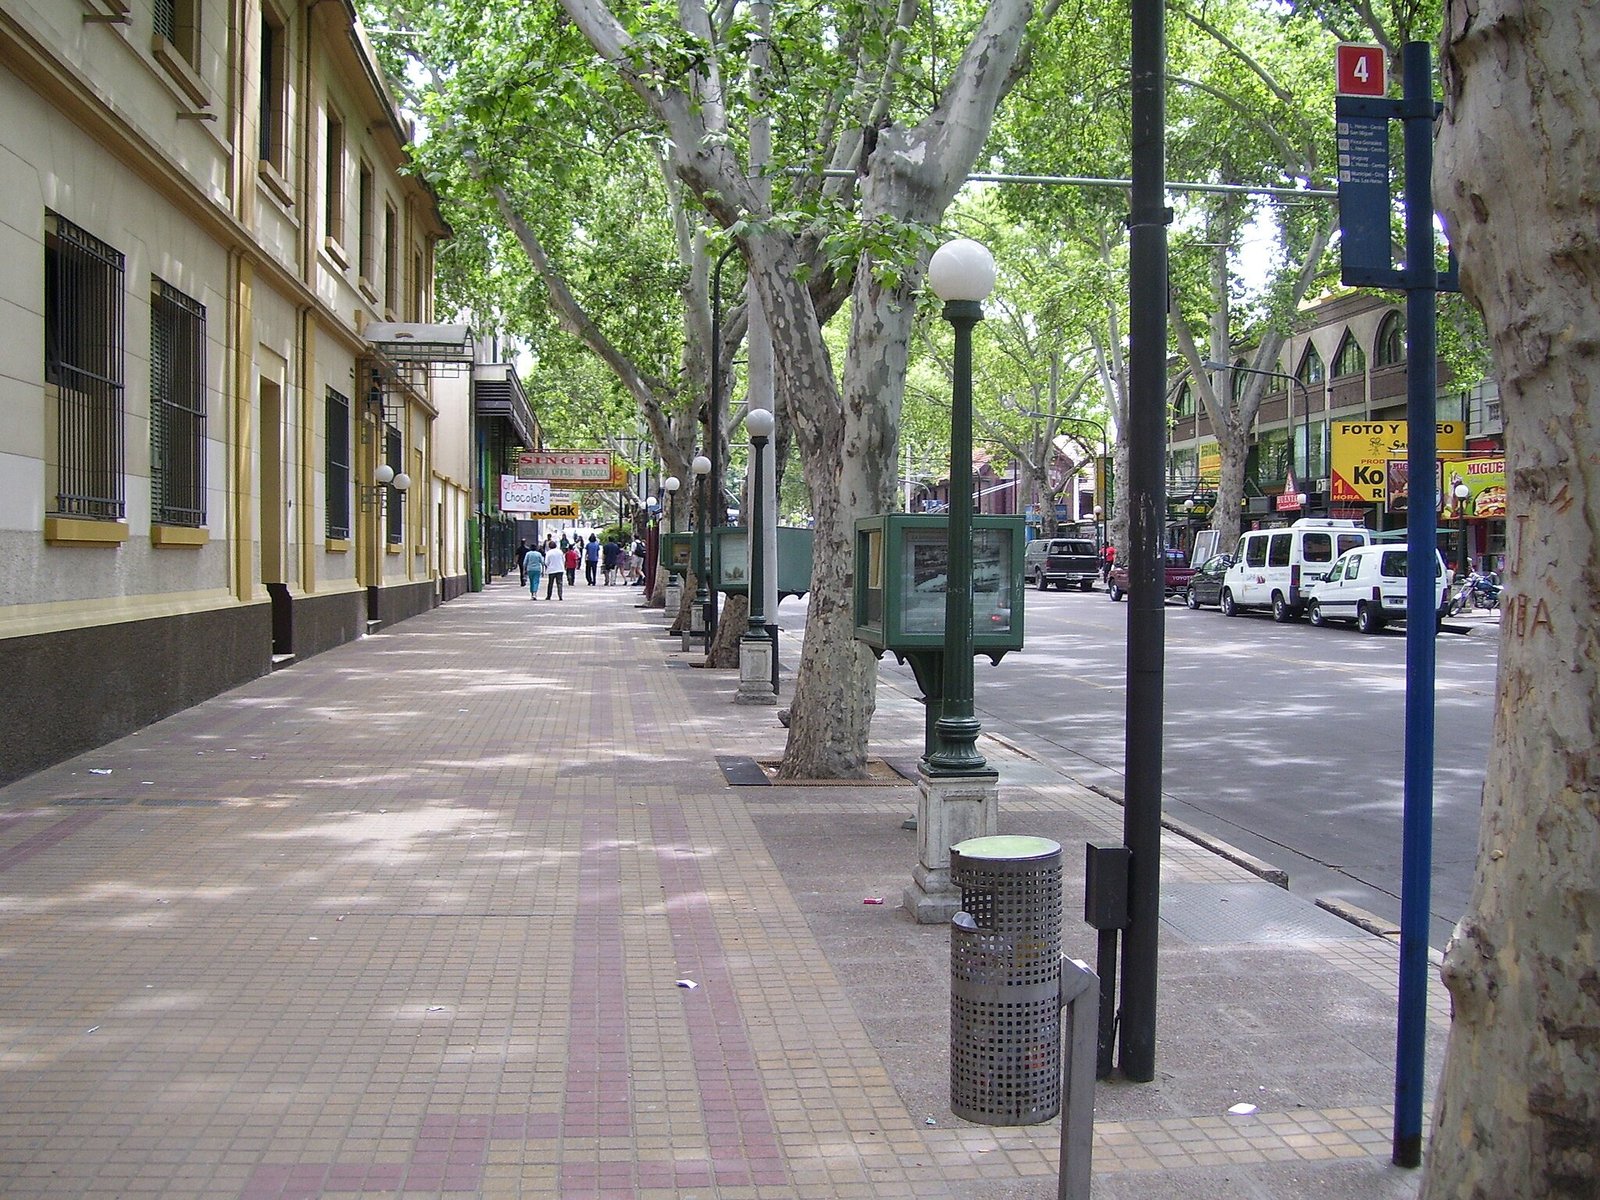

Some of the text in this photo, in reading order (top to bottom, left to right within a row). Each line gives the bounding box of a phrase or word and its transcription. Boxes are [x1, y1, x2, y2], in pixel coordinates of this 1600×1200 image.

[1354, 57, 1369, 83] 4
[1342, 425, 1383, 435] FOTO
[1389, 424, 1400, 434] Y
[520, 456, 608, 465] SINGER
[1334, 479, 1343, 494] 1
[505, 491, 545, 504] Chocolate
